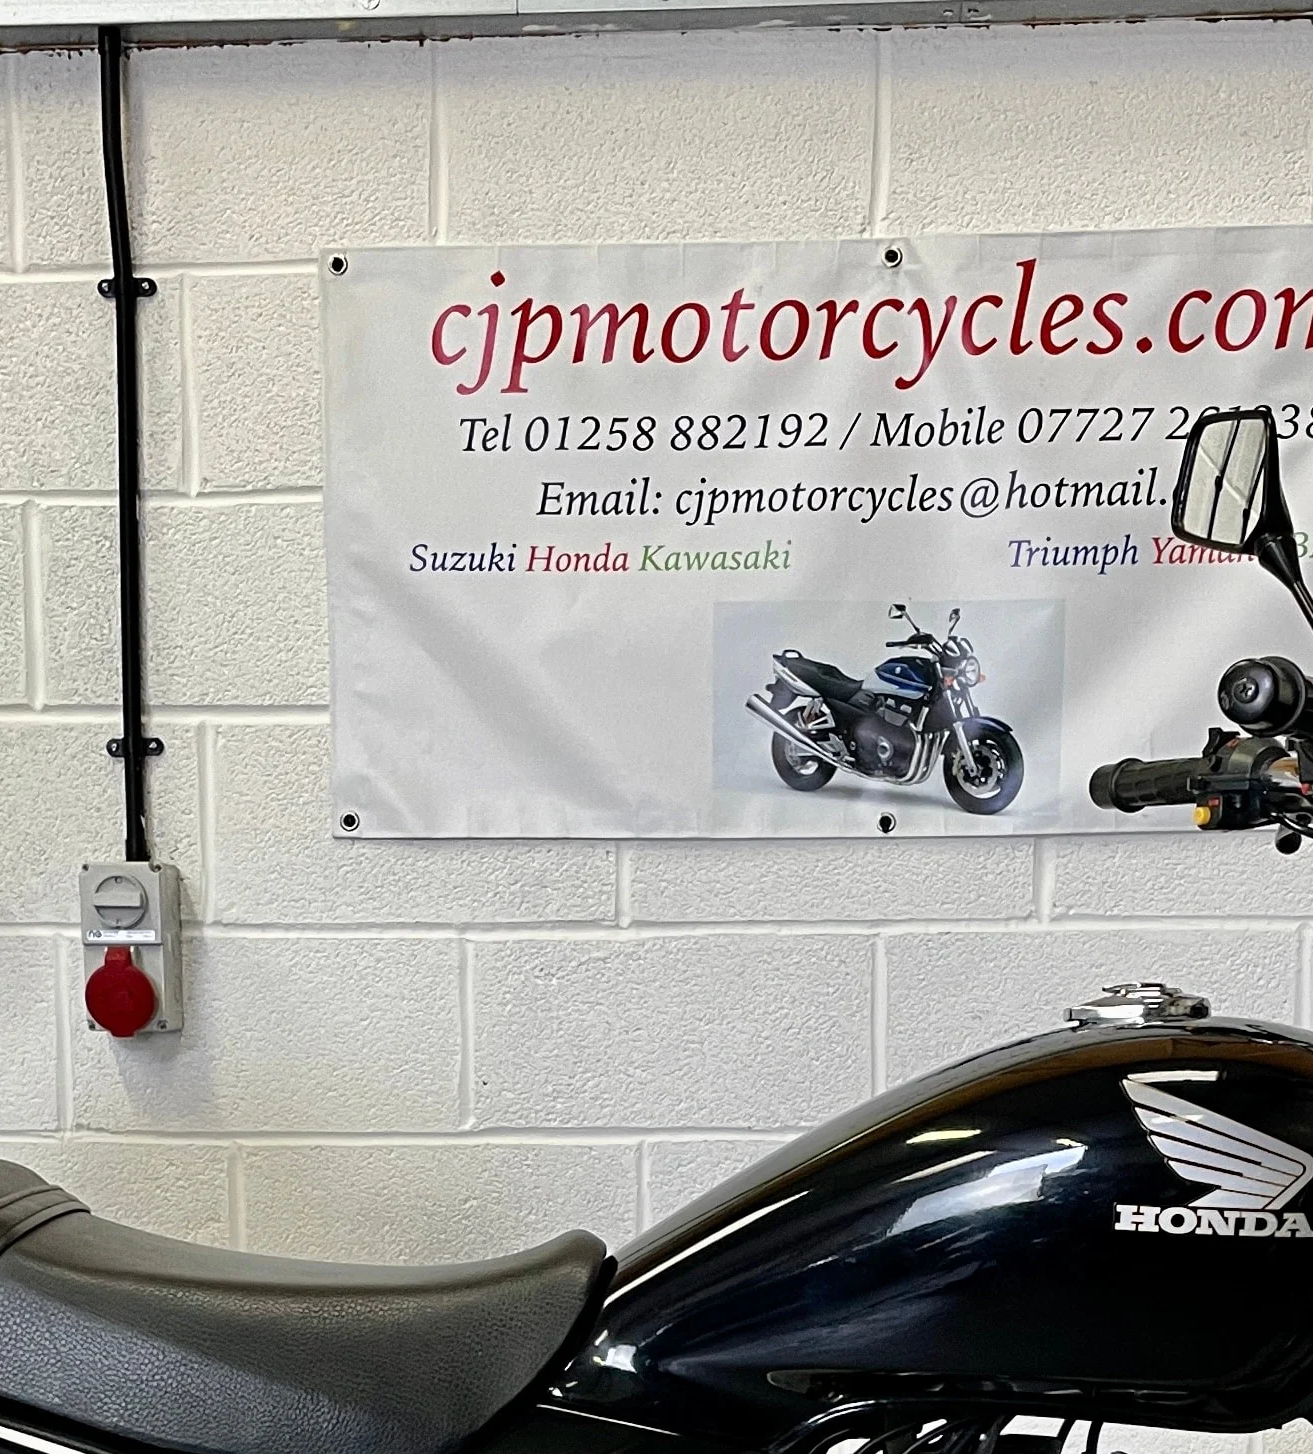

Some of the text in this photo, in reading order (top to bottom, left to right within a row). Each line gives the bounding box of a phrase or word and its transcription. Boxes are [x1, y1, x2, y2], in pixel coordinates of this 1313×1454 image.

[459, 416, 512, 452] Tel
[524, 415, 656, 452] 01258
[669, 412, 828, 452] 882192
[839, 411, 862, 450] /
[870, 406, 1005, 448] Mobile
[1017, 406, 1156, 444] 07727
[535, 466, 1174, 527] Email: cjpmotorcycles@hotmail.
[409, 540, 792, 573] Suzuki Honda Kawasaki
[1007, 533, 1139, 576] Triumph
